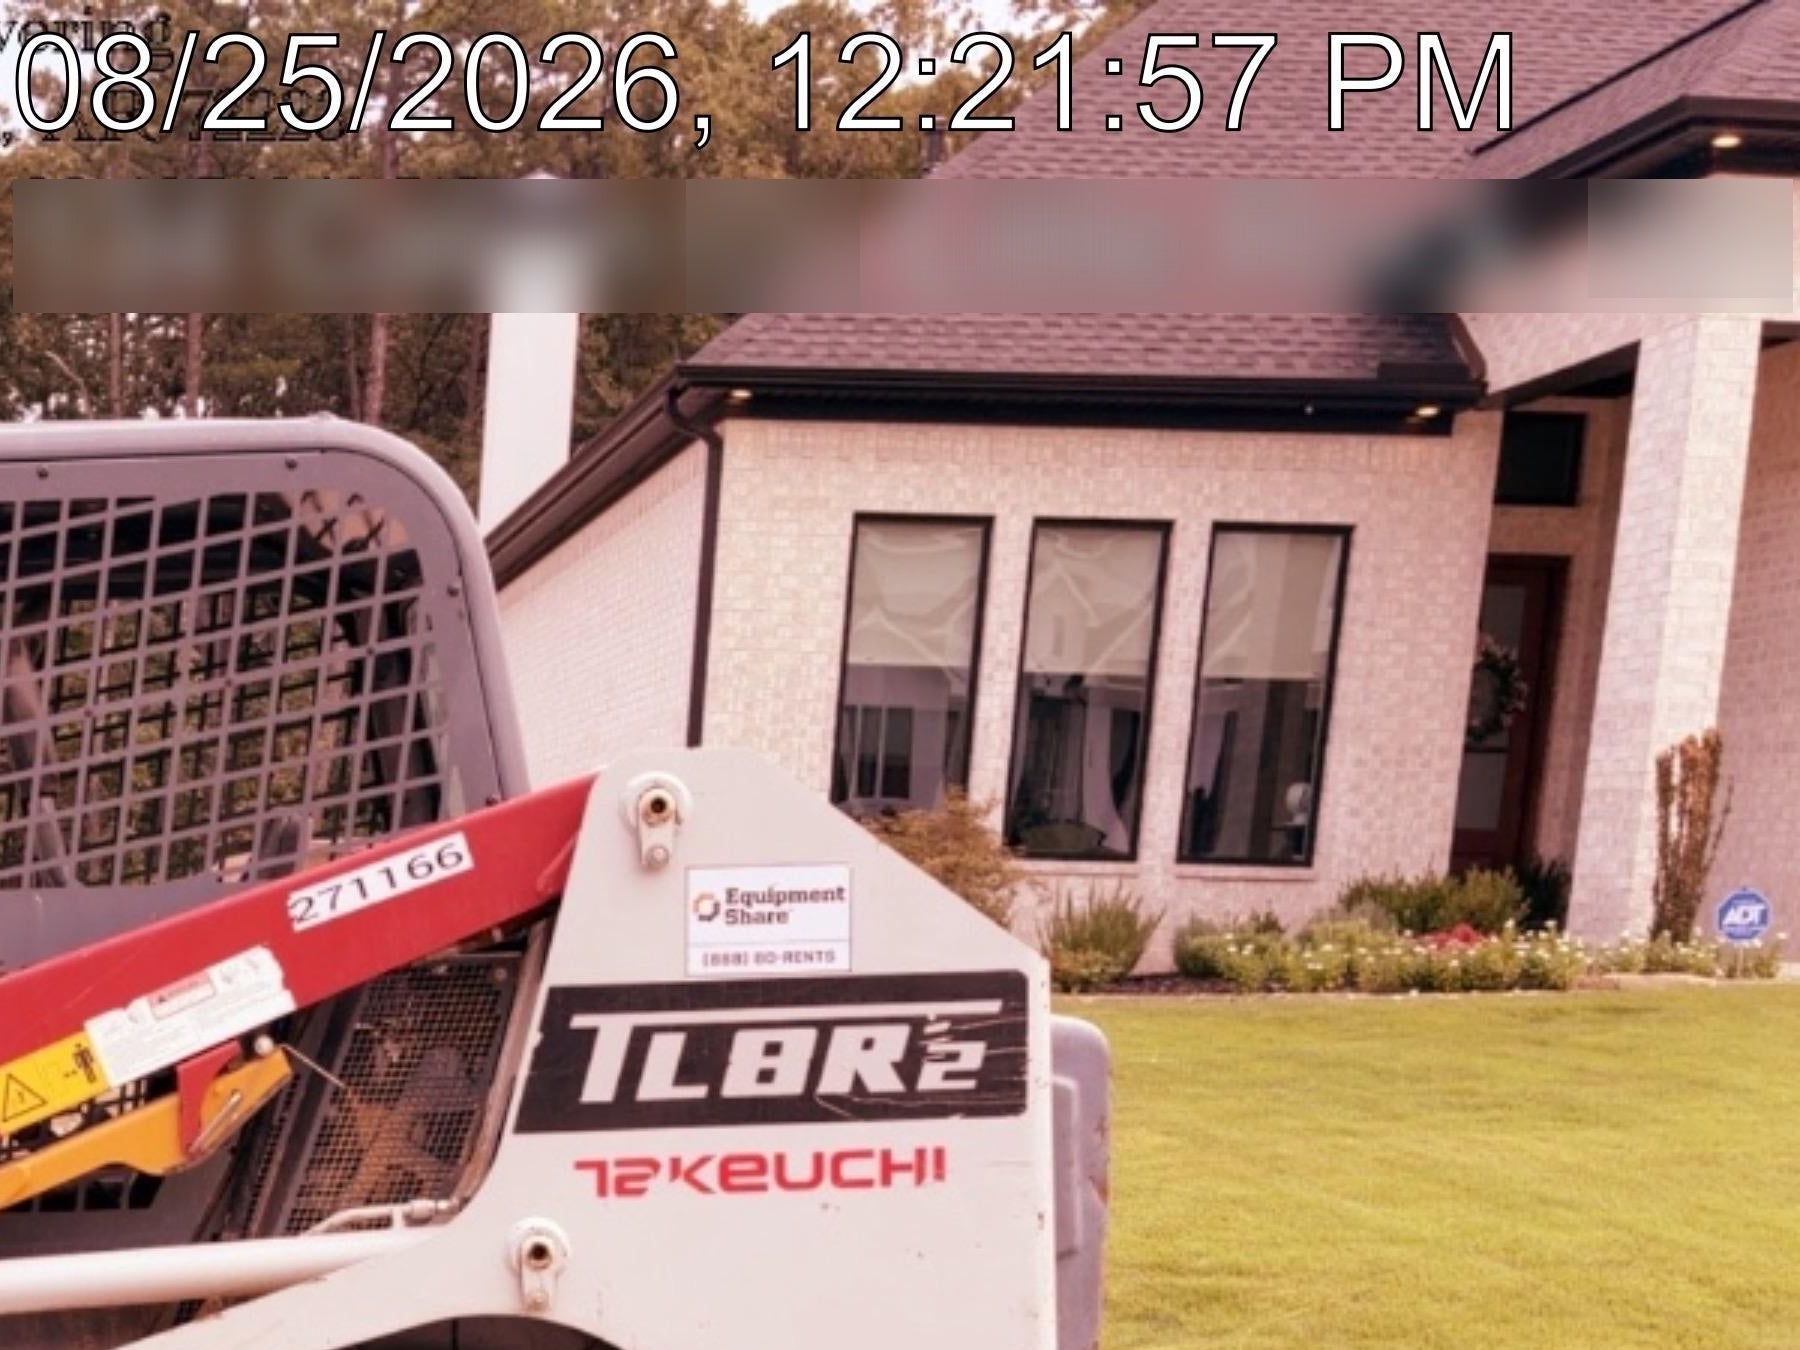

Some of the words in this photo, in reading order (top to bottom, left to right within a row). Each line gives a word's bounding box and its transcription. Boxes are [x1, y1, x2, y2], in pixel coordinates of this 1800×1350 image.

[290, 842, 463, 924] 271166
[725, 886, 845, 907] Equipment
[725, 908, 789, 925] Share
[1723, 904, 1765, 925] ADT
